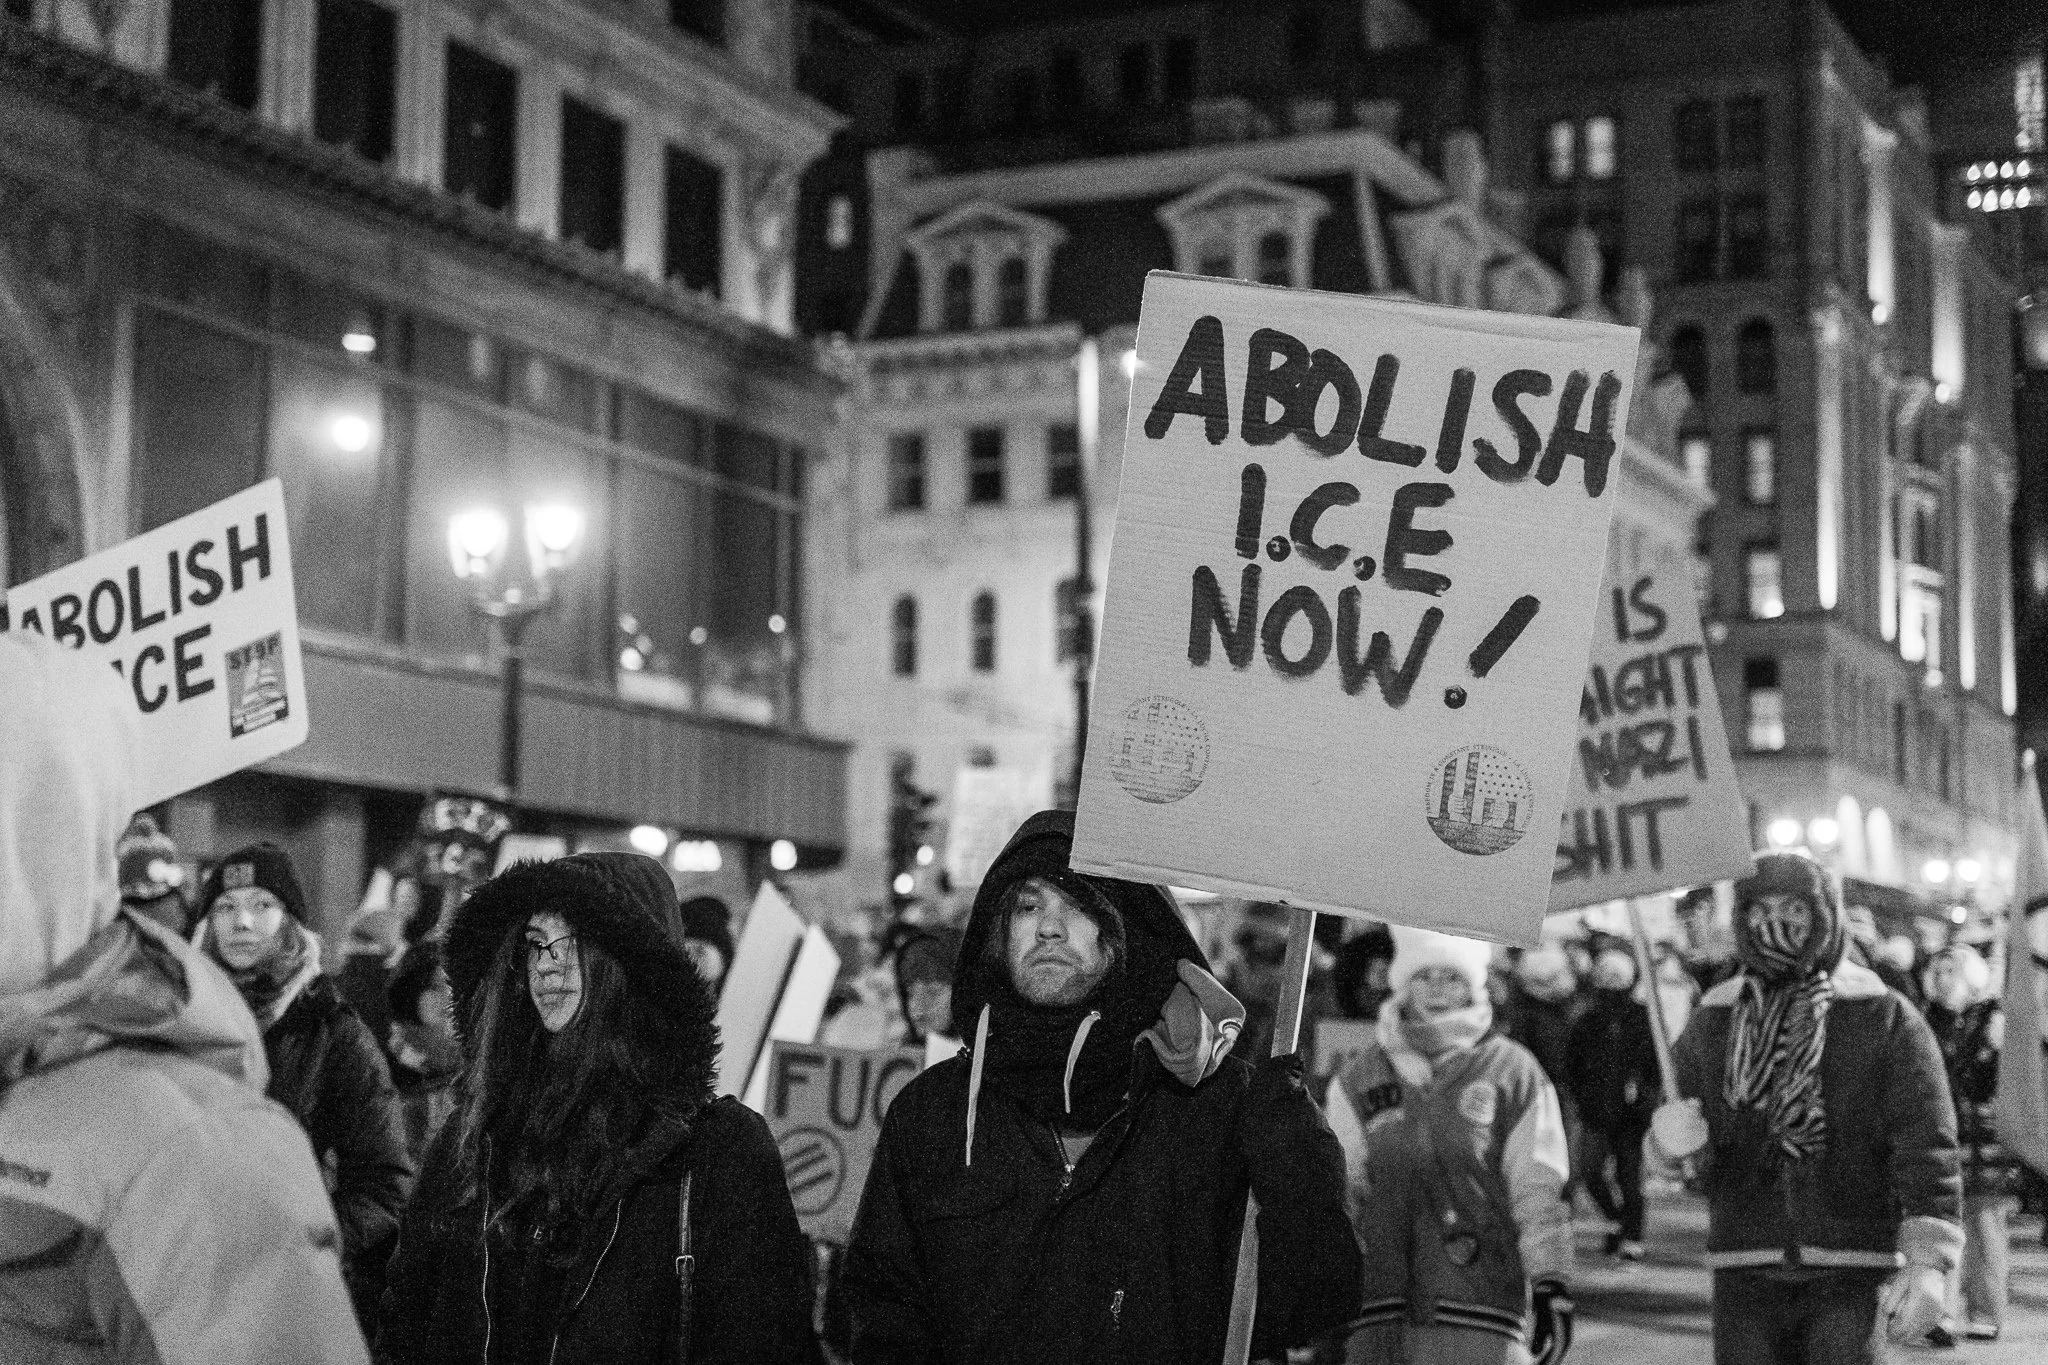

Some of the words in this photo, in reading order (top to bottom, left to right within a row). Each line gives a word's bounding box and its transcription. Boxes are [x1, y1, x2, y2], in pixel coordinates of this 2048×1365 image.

[1143, 315, 1622, 498] ABOLISH
[1187, 563, 1541, 710] NOW!
[1612, 576, 1667, 643] IS
[110, 624, 216, 714] CE
